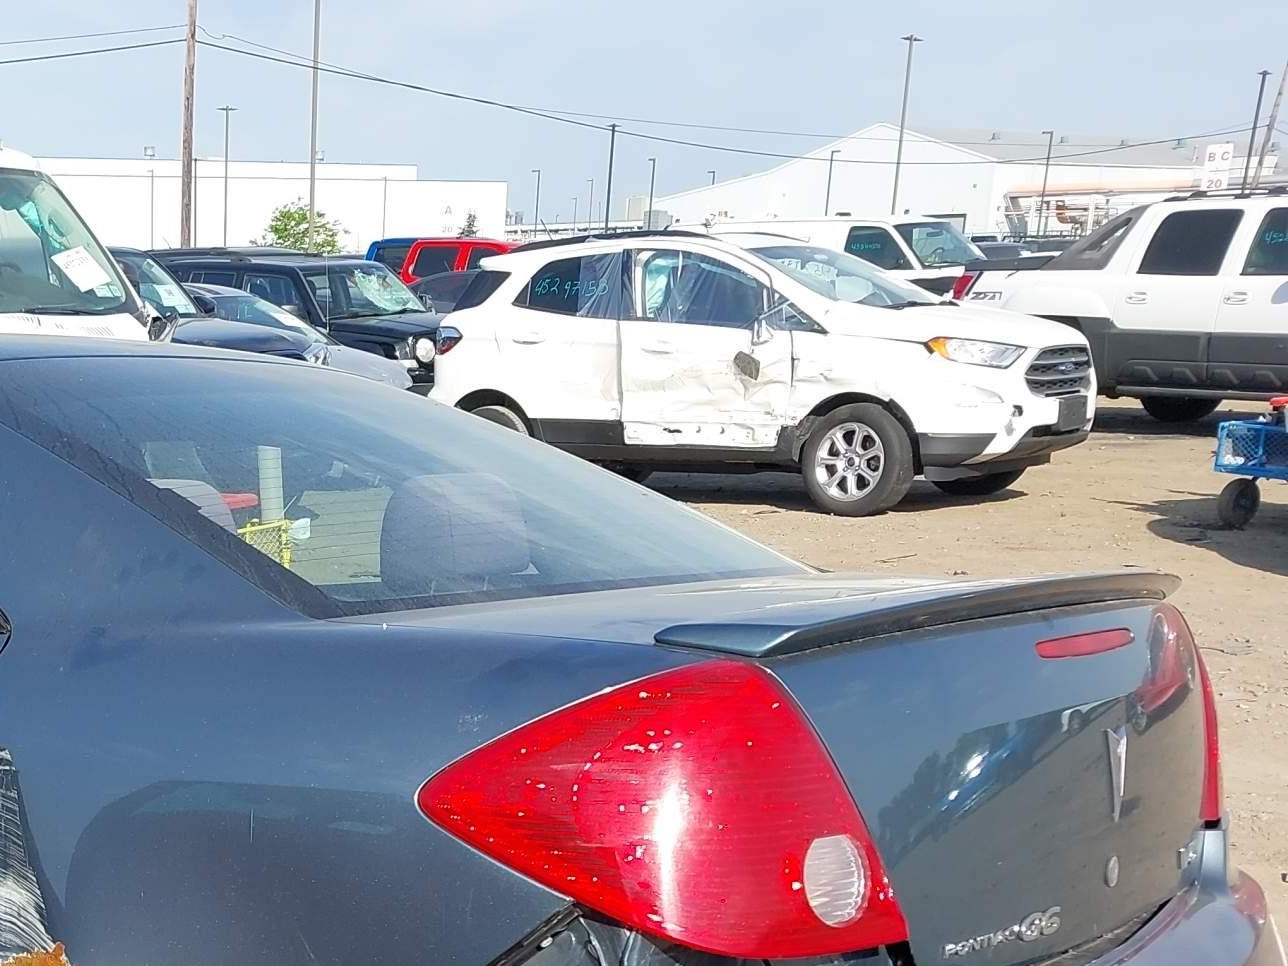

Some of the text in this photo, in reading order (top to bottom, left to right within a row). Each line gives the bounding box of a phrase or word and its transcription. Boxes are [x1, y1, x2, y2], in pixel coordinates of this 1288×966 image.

[1208, 151, 1230, 162] B C
[1206, 179, 1222, 189] 20
[535, 278, 560, 296] 452
[943, 905, 1062, 960] PONTIAC G6
